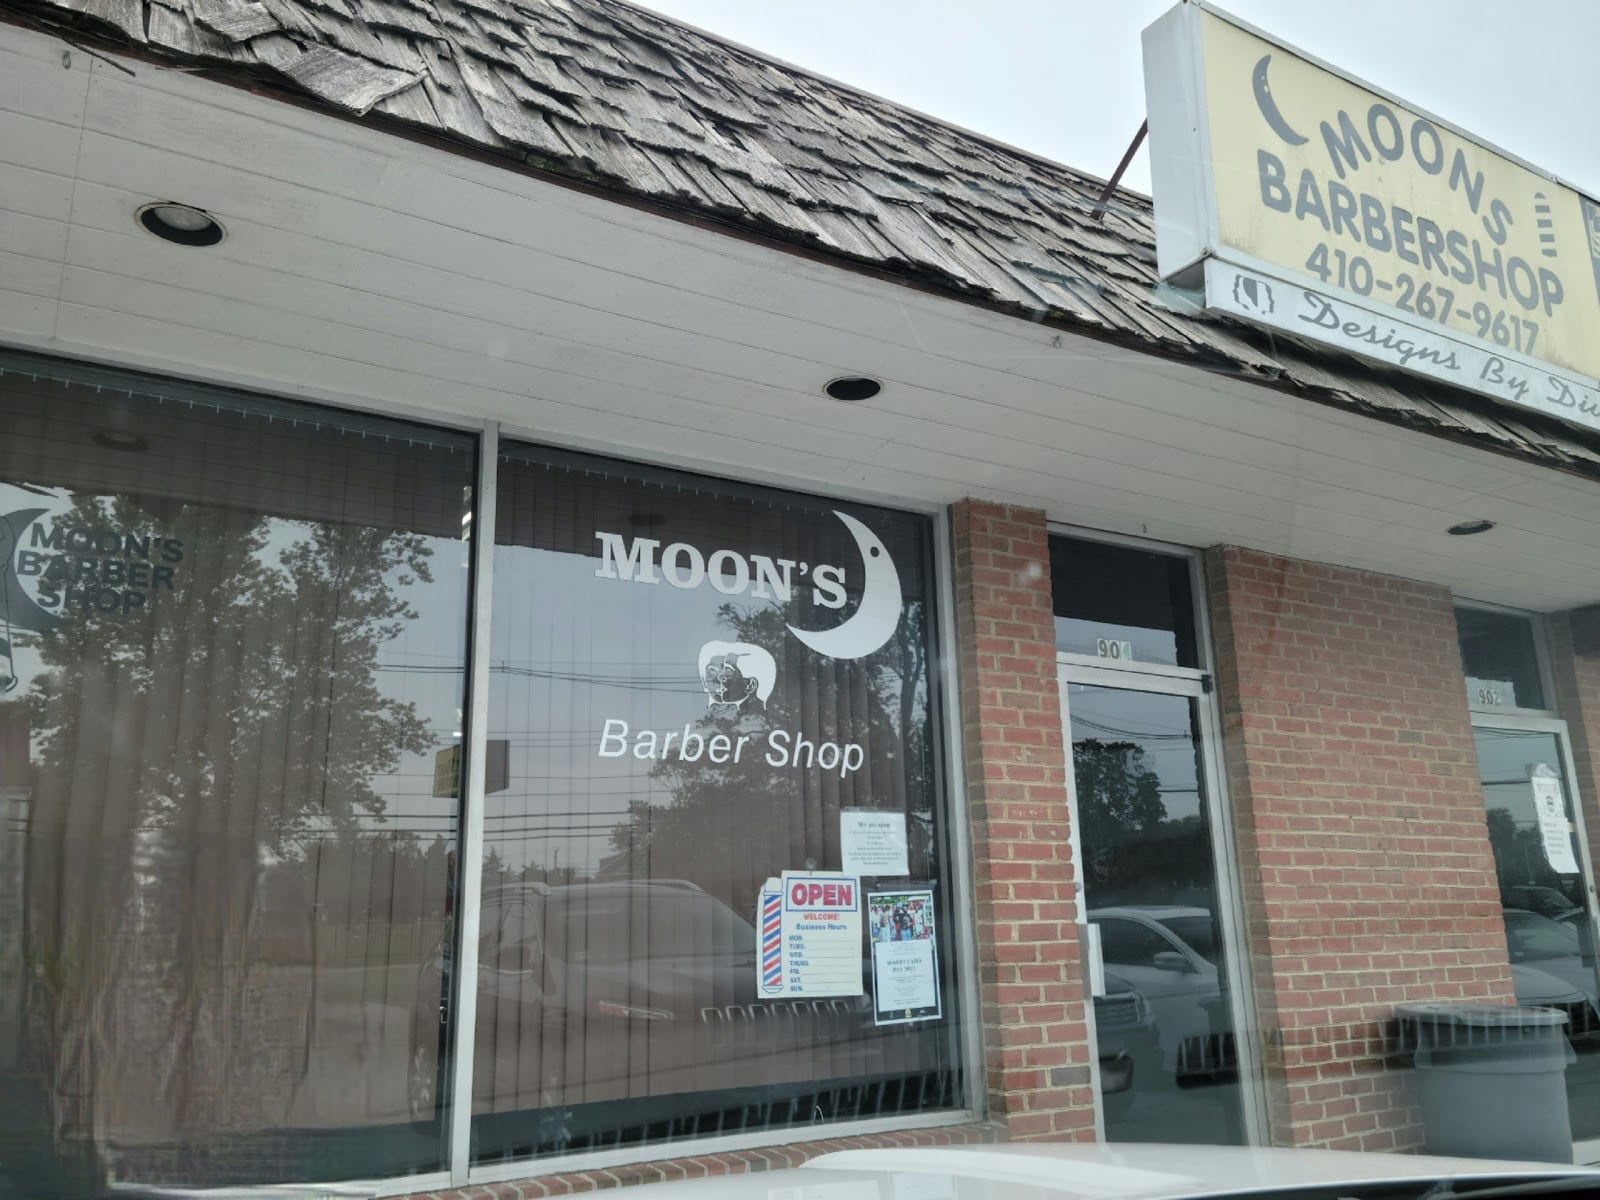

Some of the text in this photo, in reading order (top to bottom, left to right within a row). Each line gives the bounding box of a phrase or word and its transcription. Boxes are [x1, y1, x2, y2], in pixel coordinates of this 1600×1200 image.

[1257, 149, 1565, 317] BARBERSHOP
[1305, 243, 1540, 356] 410-267-9617
[1298, 290, 1462, 371] Designs
[1479, 356, 1530, 401] By
[29, 522, 185, 564] MOON'S
[16, 550, 175, 591] BARBER
[594, 531, 848, 609] MOON'S
[36, 579, 147, 615] SHOP
[598, 718, 865, 779] Barber Shop
[791, 883, 852, 906] OPEN
[796, 923, 847, 931] Business Hours
[803, 913, 840, 921] WELCOME!
